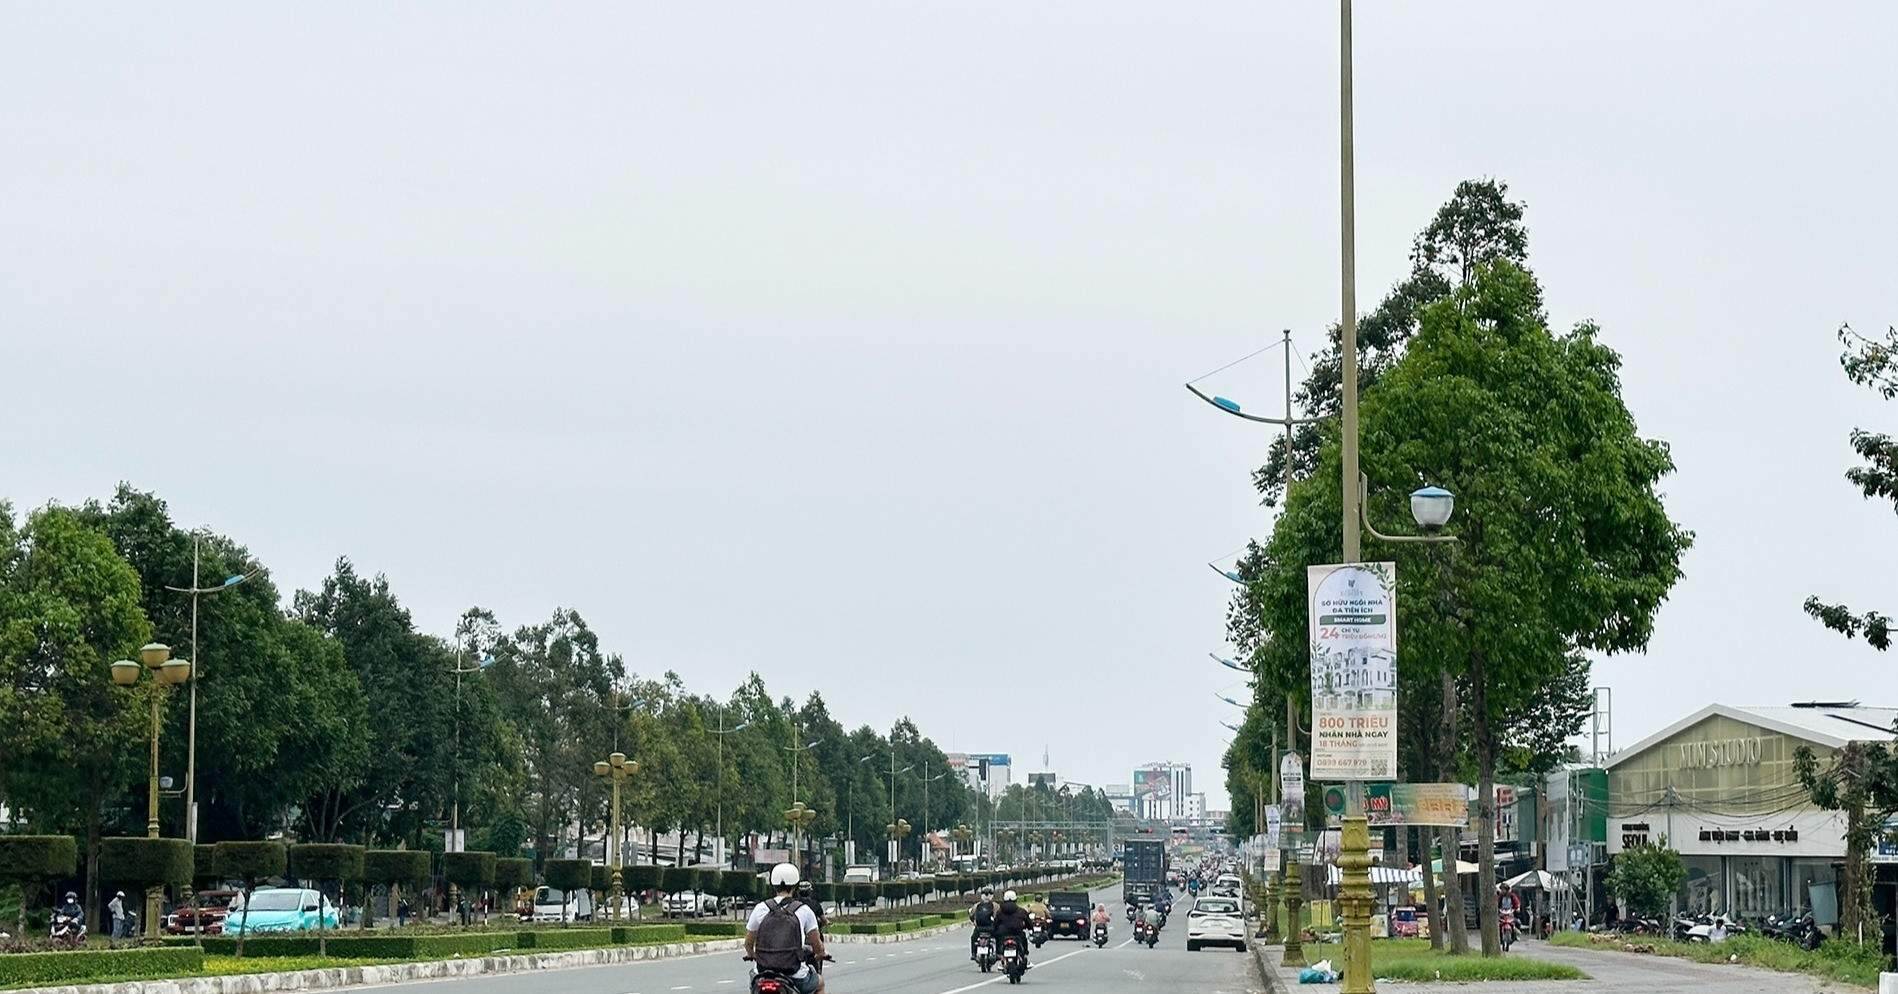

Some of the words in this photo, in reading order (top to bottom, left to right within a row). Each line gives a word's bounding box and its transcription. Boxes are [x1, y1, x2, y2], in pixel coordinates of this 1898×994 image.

[1320, 627, 1339, 640] 24
[1319, 717, 1344, 729] 800
[1708, 737, 1762, 767] STUDIO
